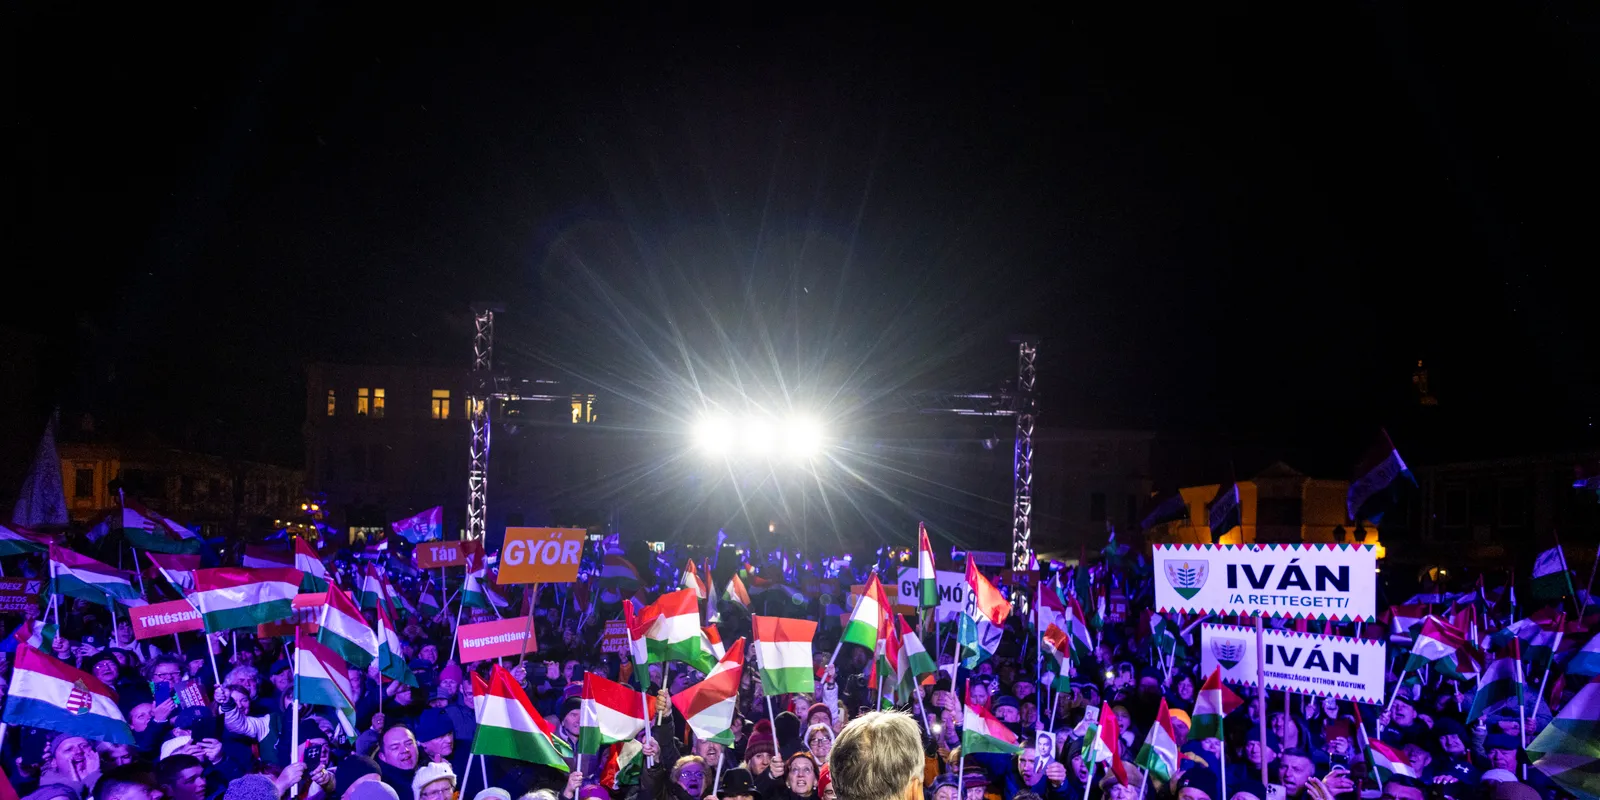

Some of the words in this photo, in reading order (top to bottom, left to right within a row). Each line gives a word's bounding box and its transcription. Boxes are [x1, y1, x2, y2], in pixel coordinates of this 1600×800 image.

[430, 547, 457, 561] Táp
[503, 532, 580, 566] GYŐR
[1227, 558, 1350, 592] IVÁN
[1249, 594, 1349, 608] RETTEGETT/
[1265, 644, 1359, 675] IVÁN
[1312, 677, 1335, 687] OTTHON
[1337, 680, 1366, 690] VAGYUNK
